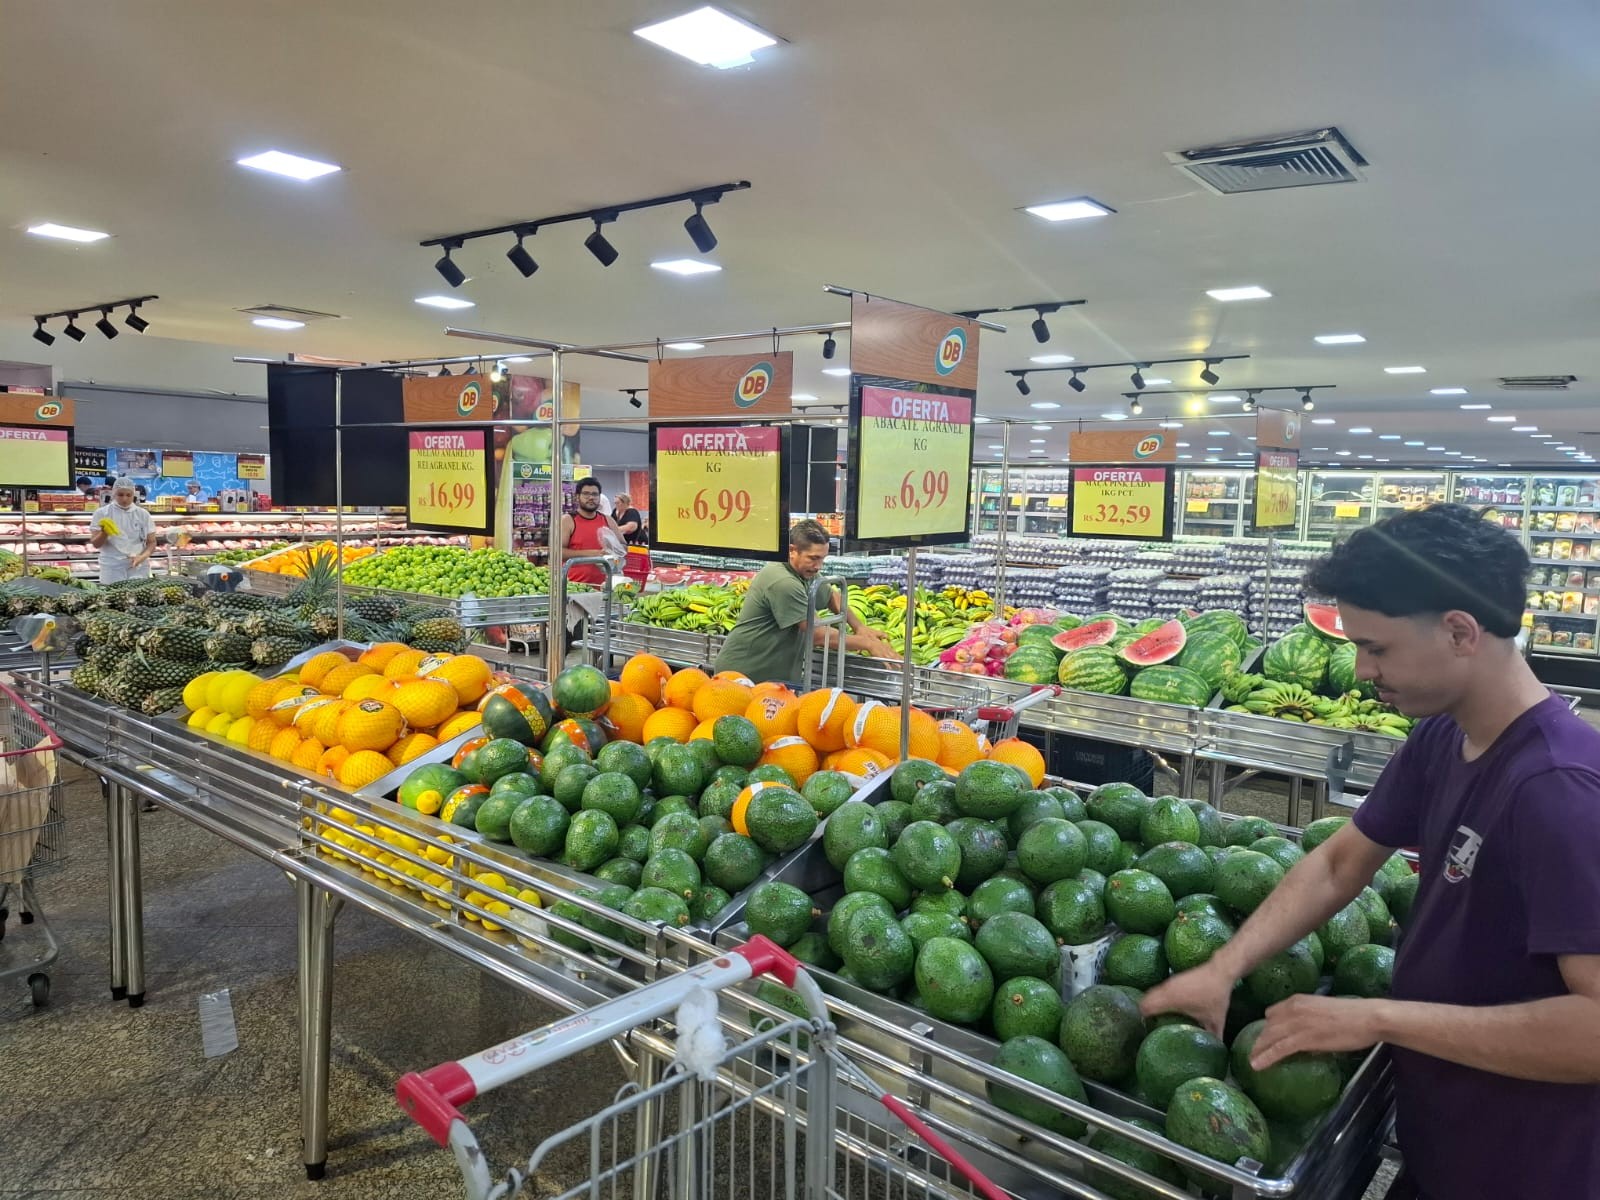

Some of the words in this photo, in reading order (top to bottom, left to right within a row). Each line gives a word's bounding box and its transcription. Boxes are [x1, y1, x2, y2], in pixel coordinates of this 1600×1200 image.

[942, 340, 960, 362] DB
[743, 376, 766, 394] DB
[463, 392, 476, 406] DB
[42, 406, 57, 415] DB
[891, 396, 949, 421] OFERTA
[873, 416, 919, 431] ABACATE
[922, 420, 963, 434] AGRANEL
[424, 436, 465, 448] OFERTA
[682, 433, 748, 450] OFERTA
[914, 438, 927, 451] KG
[1140, 441, 1157, 451] DB
[706, 462, 721, 473] KG
[1094, 471, 1142, 481] OFERTA
[428, 481, 475, 513] 16,99
[900, 470, 949, 517] 6,99
[693, 488, 751, 528] 6,99
[1095, 504, 1151, 526] 32,59
